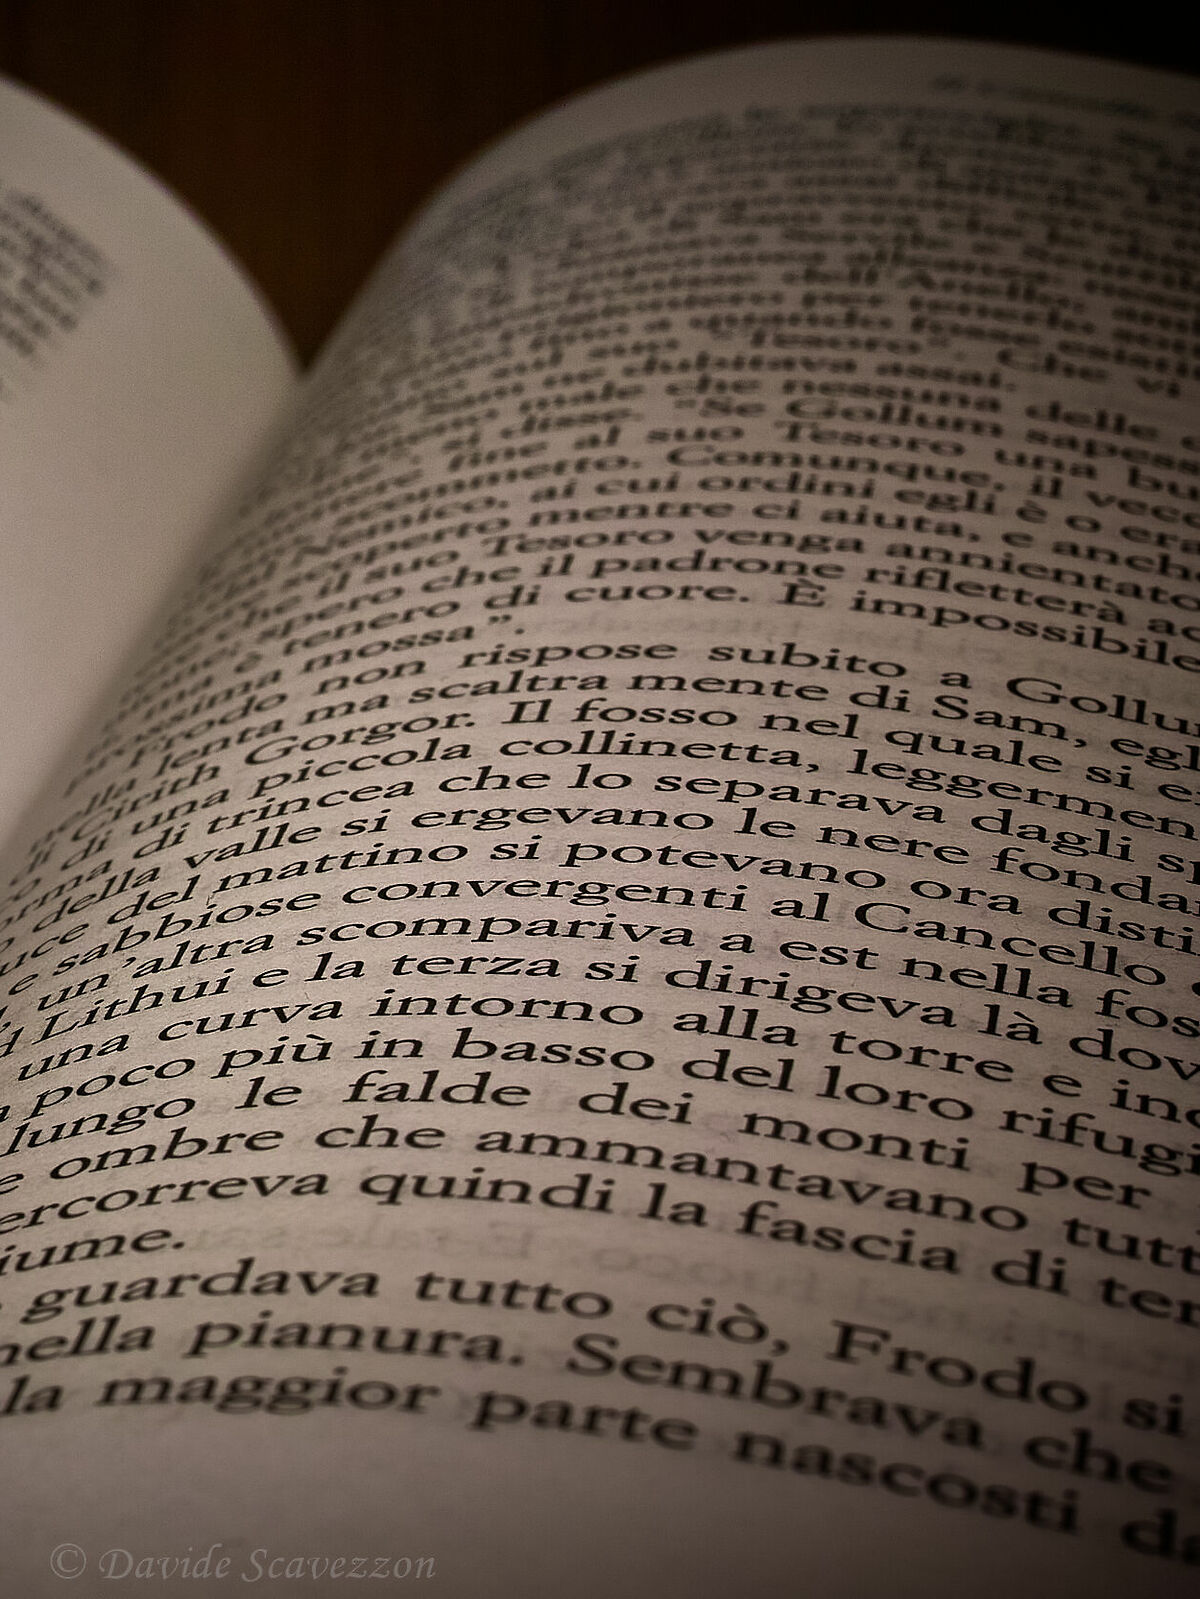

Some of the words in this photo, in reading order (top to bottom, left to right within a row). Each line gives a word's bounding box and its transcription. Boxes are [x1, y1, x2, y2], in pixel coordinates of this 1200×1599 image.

[484, 530, 674, 556] Tesoro
[695, 530, 863, 553] venga
[529, 502, 733, 526] mentre
[821, 506, 980, 542] aiuta,
[698, 472, 874, 498] ordini
[895, 483, 1004, 515] egli
[484, 585, 540, 609] di
[565, 586, 749, 602] cuore.
[777, 578, 826, 607] È
[845, 590, 1200, 677] impossibile
[538, 554, 574, 577] il
[590, 549, 844, 579] padrone
[865, 563, 1127, 631] rifletterà
[301, 695, 389, 725] ma
[409, 670, 608, 703] scaltra
[627, 675, 829, 701] mente
[849, 685, 910, 712] di
[928, 695, 1087, 749] Sam,
[315, 654, 426, 696] non
[458, 644, 677, 668] rispose
[708, 642, 907, 677] subito
[940, 672, 972, 689] a
[128, 798, 229, 835] una
[245, 734, 472, 802] piccola
[499, 730, 819, 773] collinetta,
[245, 710, 475, 771] Gorgor.
[501, 699, 552, 724] Il
[571, 698, 738, 726] fosso
[758, 714, 859, 739] nel
[885, 731, 1063, 773] quale
[1086, 766, 1134, 790] si
[201, 780, 414, 836] trincea
[439, 765, 551, 792] che
[574, 763, 632, 789] lo
[654, 774, 947, 824] separava
[971, 809, 1134, 862] dagli
[31, 866, 160, 933] della
[181, 816, 322, 869] valle
[340, 809, 391, 836] si
[411, 808, 714, 831] ergevano
[733, 808, 796, 838] le
[816, 827, 969, 864] nere
[107, 877, 201, 924] del
[218, 843, 468, 893] mattino
[490, 835, 542, 860] si
[559, 843, 886, 889] potevano
[910, 881, 1023, 915] ora
[37, 935, 274, 1012] un’altra
[296, 913, 695, 947] scompariva
[720, 934, 755, 953] a
[780, 942, 879, 970] est
[898, 958, 1073, 1008] nella
[52, 890, 322, 975] sabbiose
[342, 880, 748, 911] convergenti
[771, 893, 829, 922] al
[853, 895, 1167, 989] Cancello
[17, 1035, 129, 1081] una
[158, 1001, 343, 1041] curva
[369, 989, 643, 1025] intorno
[673, 1005, 798, 1047] alla
[829, 1031, 1014, 1082] torre
[1043, 1075, 1082, 1097] e
[31, 968, 235, 1045] Lithui
[253, 969, 289, 987] e
[304, 952, 365, 982] la
[392, 955, 561, 977] terza
[585, 956, 640, 982] si
[665, 958, 957, 1027] dirigeva
[977, 1004, 1043, 1045] là
[24, 1055, 196, 1121] poco
[210, 1034, 332, 1079] più
[353, 1030, 423, 1059] in
[452, 1027, 654, 1070] basso
[682, 1049, 794, 1092] del
[816, 1066, 975, 1120] loro
[49, 1127, 284, 1179] ombre
[315, 1114, 445, 1149] che
[473, 1128, 1028, 1237] ammantavano
[235, 1076, 302, 1109] le
[342, 1070, 531, 1106] falde
[579, 1082, 694, 1124] dei
[737, 1113, 970, 1172] monti
[1017, 1162, 1152, 1210] per
[359, 1167, 614, 1214] quindi
[638, 1183, 707, 1227] la
[735, 1201, 960, 1275] fascia
[991, 1249, 1069, 1296] di
[15, 1257, 379, 1324] guardava
[416, 1272, 613, 1318] tutto
[647, 1298, 789, 1356] ciò,
[827, 1320, 1090, 1412] Frodo
[1122, 1394, 1186, 1438] si
[96, 1367, 440, 1414] maggior
[471, 1391, 698, 1451] parte
[733, 1433, 1078, 1536] nascosti
[184, 1311, 524, 1366] pianura.
[566, 1334, 984, 1451] Sembrava
[1023, 1428, 1176, 1494] che
